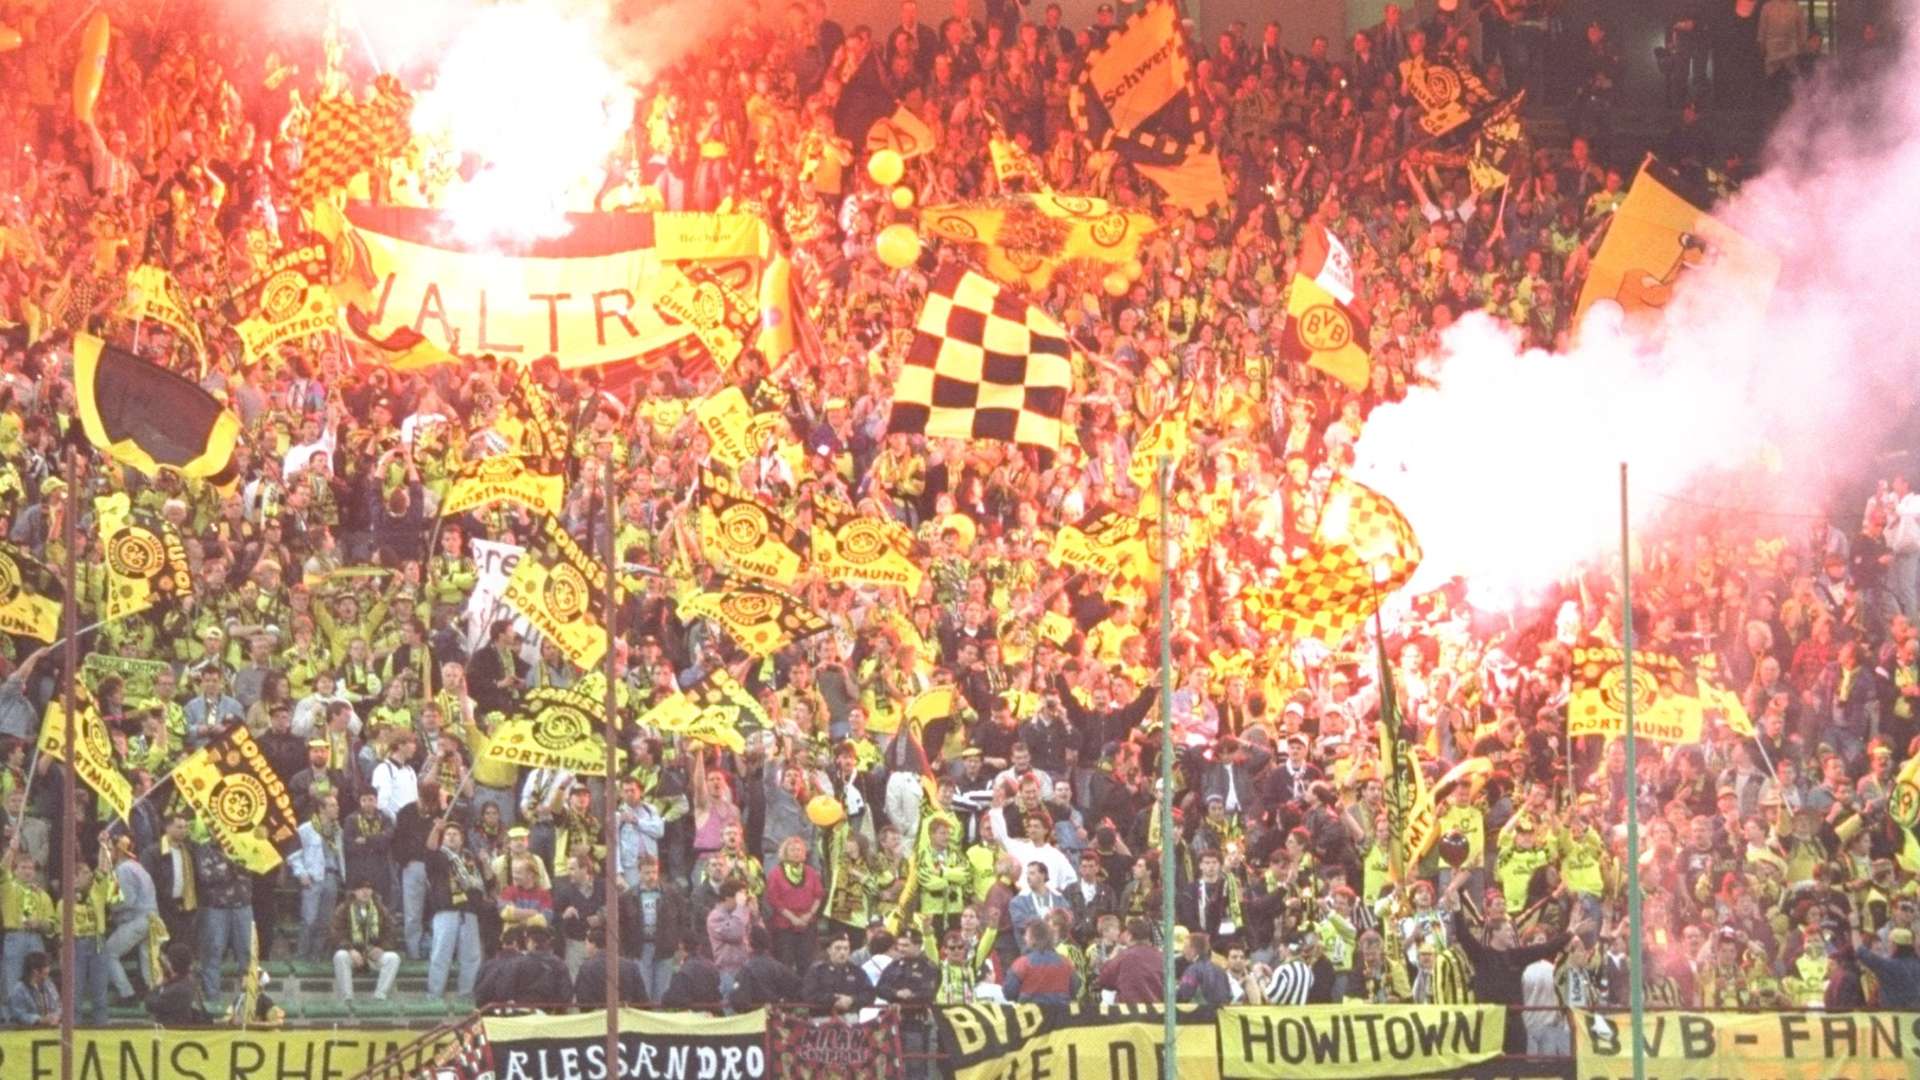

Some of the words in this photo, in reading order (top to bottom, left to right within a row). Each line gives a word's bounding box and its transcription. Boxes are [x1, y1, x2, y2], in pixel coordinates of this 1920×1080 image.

[1306, 311, 1345, 343] BVB
[1572, 646, 1684, 672] BORSSIA
[46, 736, 126, 812] DRTMUND
[489, 744, 606, 772] DORTMUND
[1239, 1010, 1485, 1065] HOWITOWN
[504, 1042, 765, 1080] ALESSANDRO
